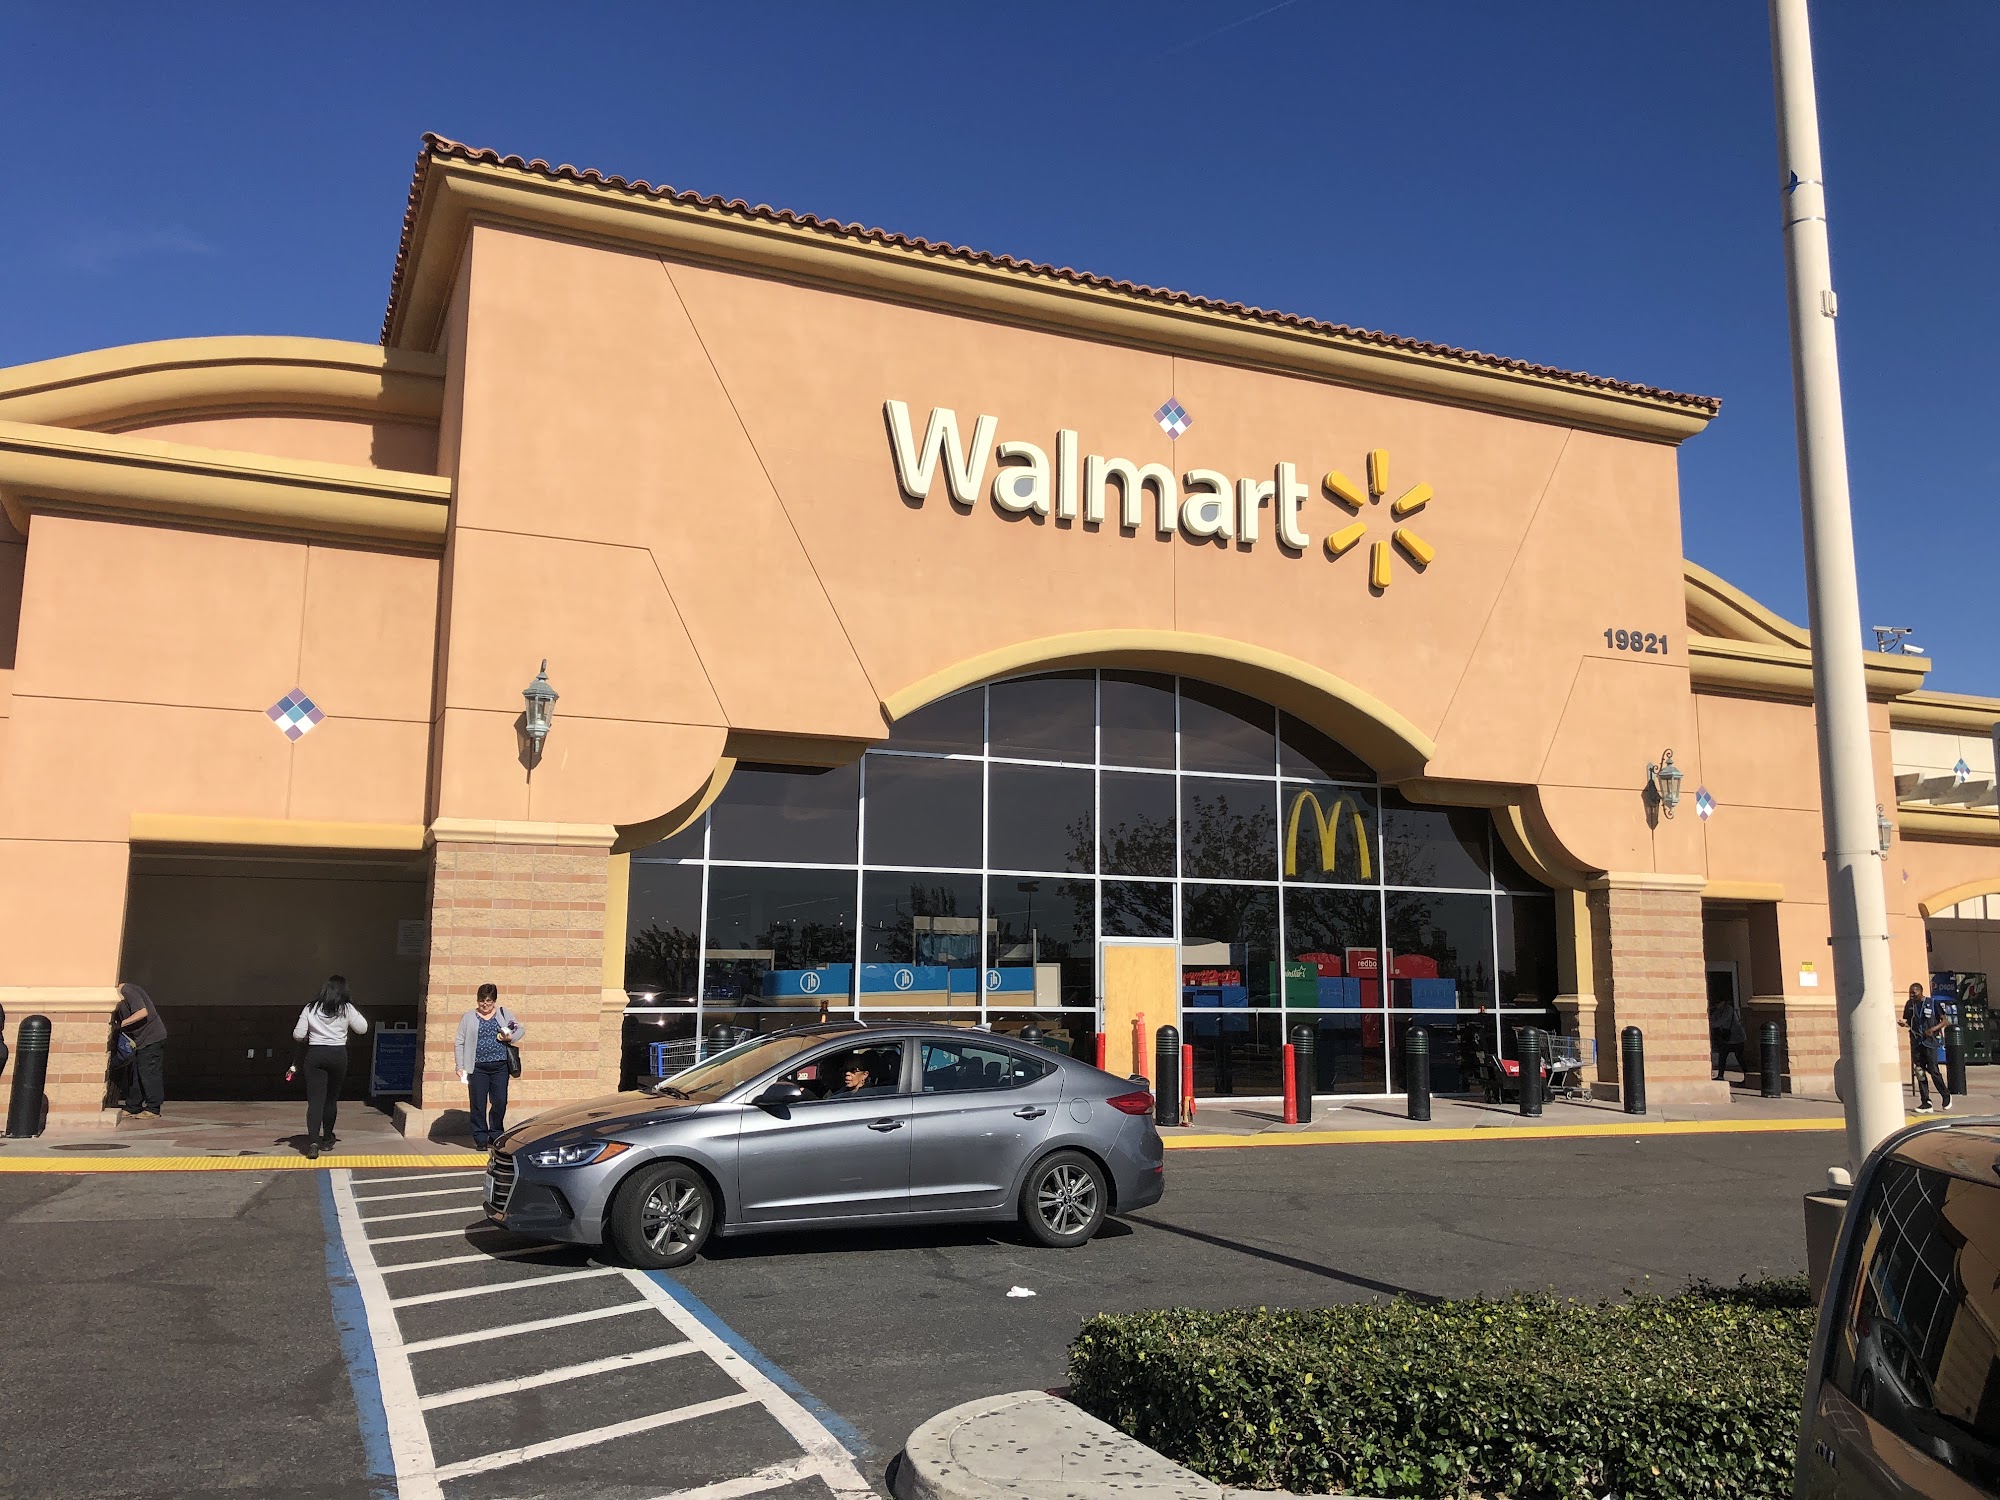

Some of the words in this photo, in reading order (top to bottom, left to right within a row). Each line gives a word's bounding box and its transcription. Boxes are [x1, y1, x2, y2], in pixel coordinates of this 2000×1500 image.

[883, 398, 1310, 551] Walmart
[1603, 627, 1668, 655] 19821
[1357, 958, 1378, 967] redbo
